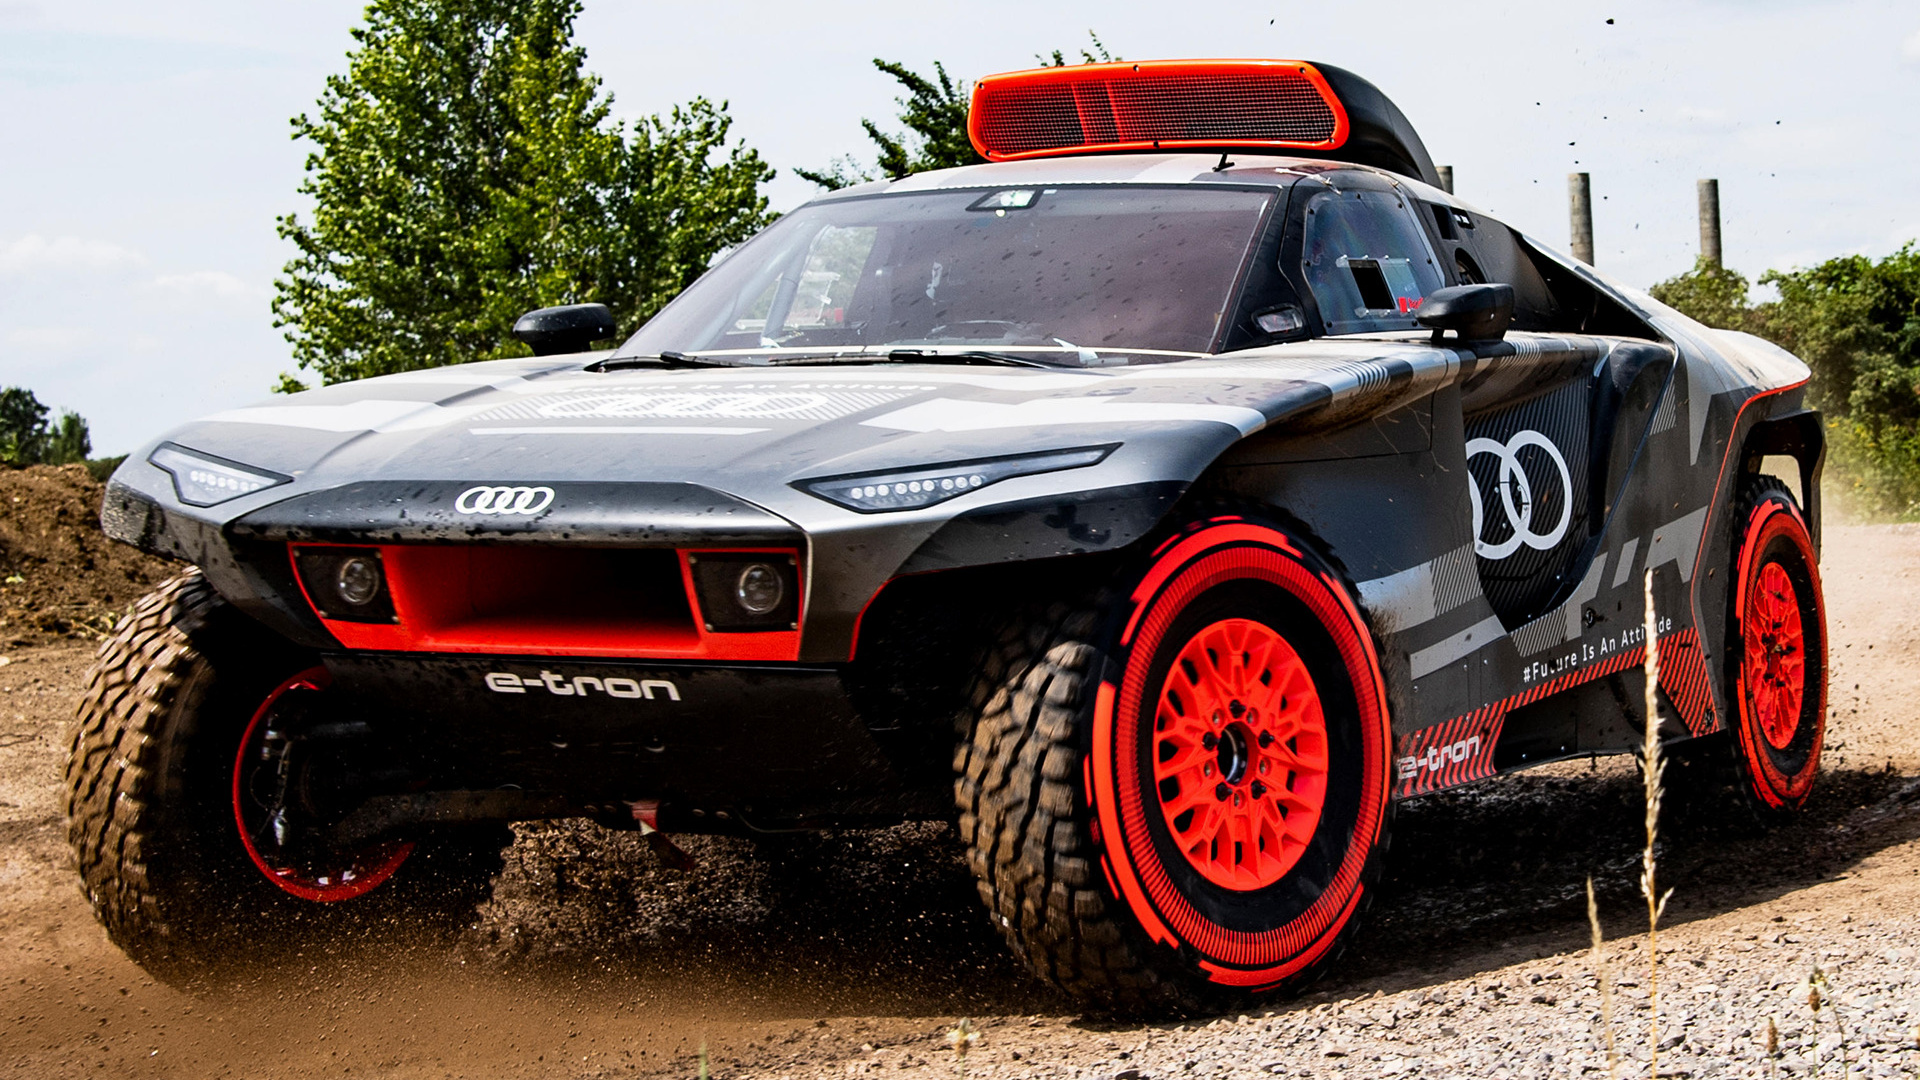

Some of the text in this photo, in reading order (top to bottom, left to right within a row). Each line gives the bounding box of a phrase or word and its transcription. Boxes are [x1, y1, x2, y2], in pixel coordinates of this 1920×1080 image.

[1582, 643, 1595, 662] Is
[1600, 637, 1616, 656] An
[1621, 616, 1672, 649] Attide
[485, 670, 681, 701] e-tron
[1397, 735, 1480, 780] e-tron
